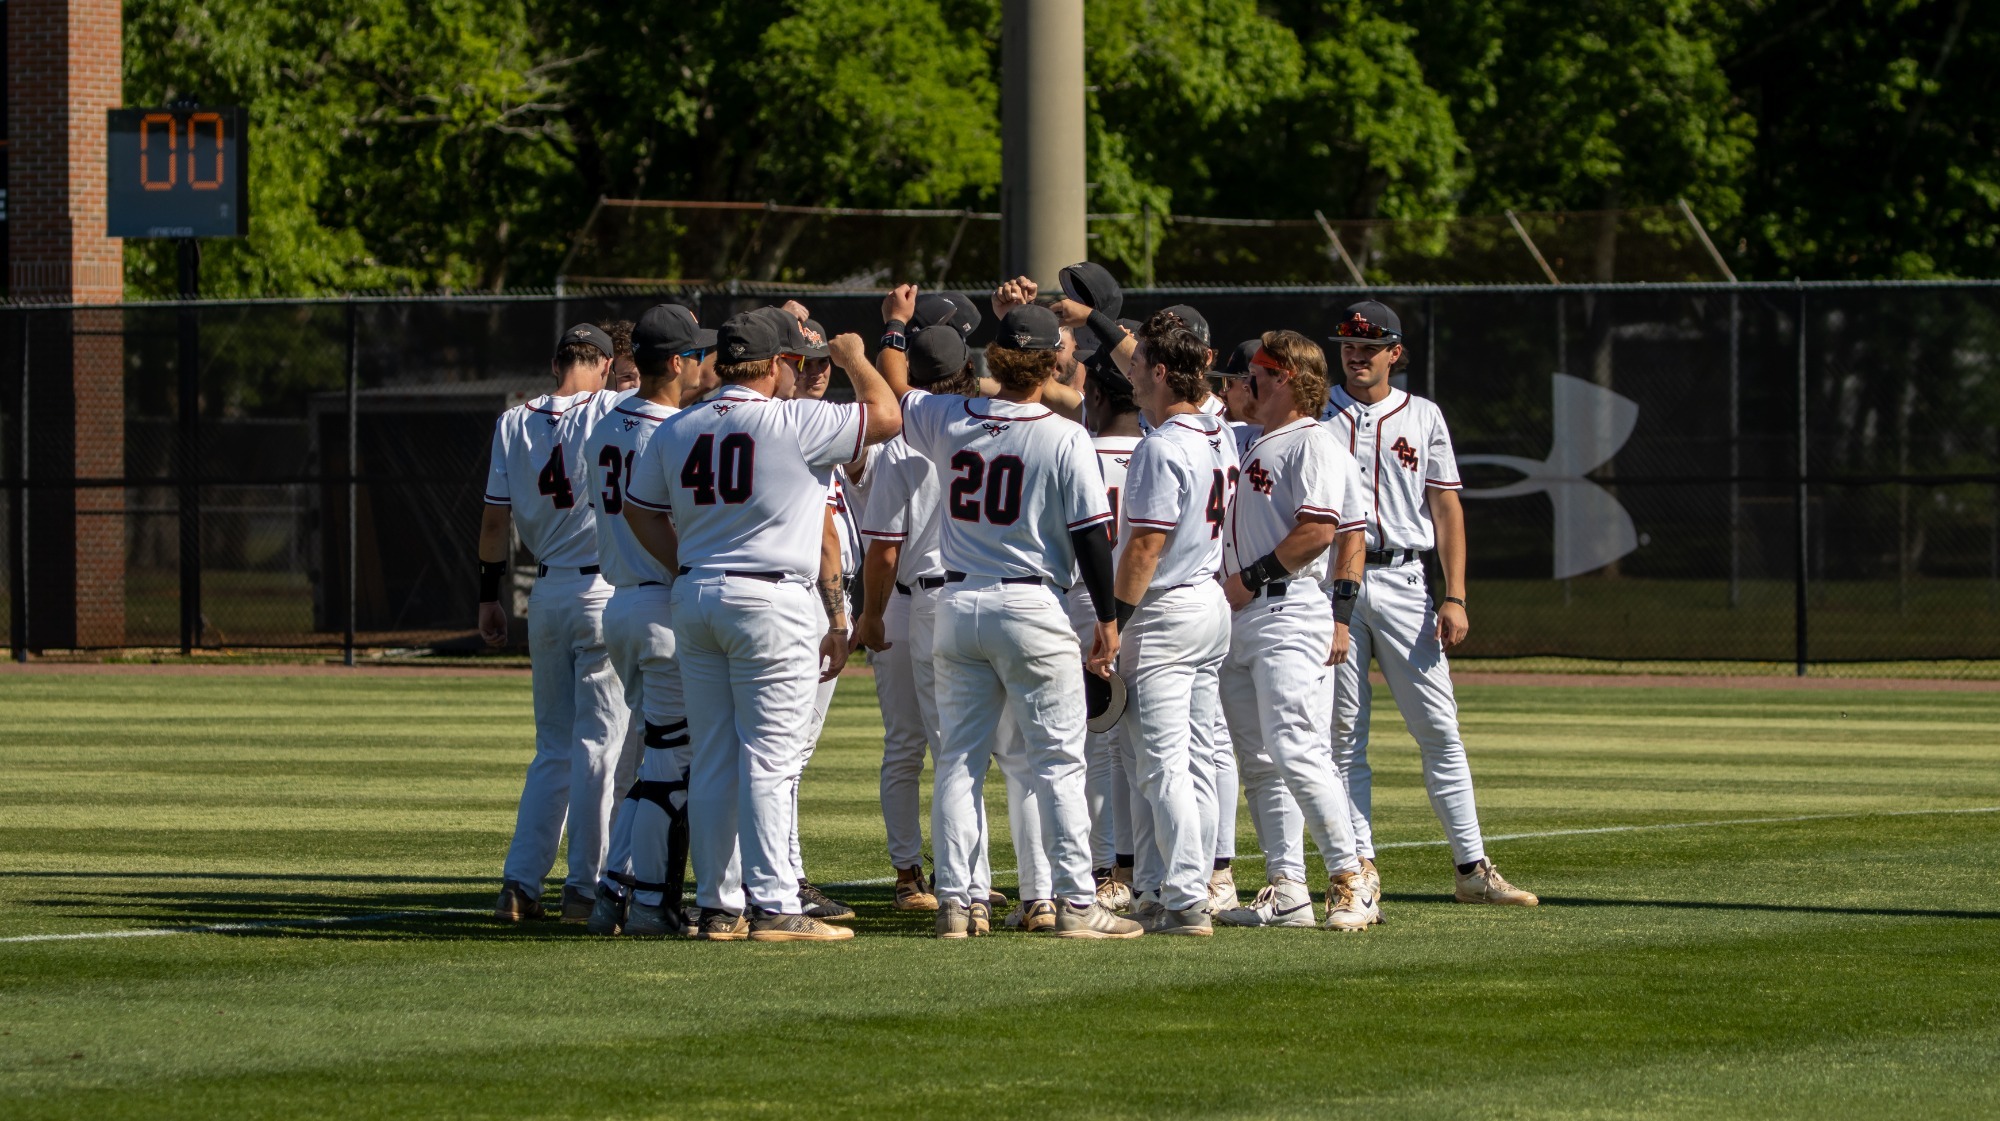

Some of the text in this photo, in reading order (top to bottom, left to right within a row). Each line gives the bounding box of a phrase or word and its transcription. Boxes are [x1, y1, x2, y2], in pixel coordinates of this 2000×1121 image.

[141, 112, 224, 191] 00
[538, 442, 575, 509] 4
[680, 432, 755, 506] 40
[950, 449, 1025, 526] 20
